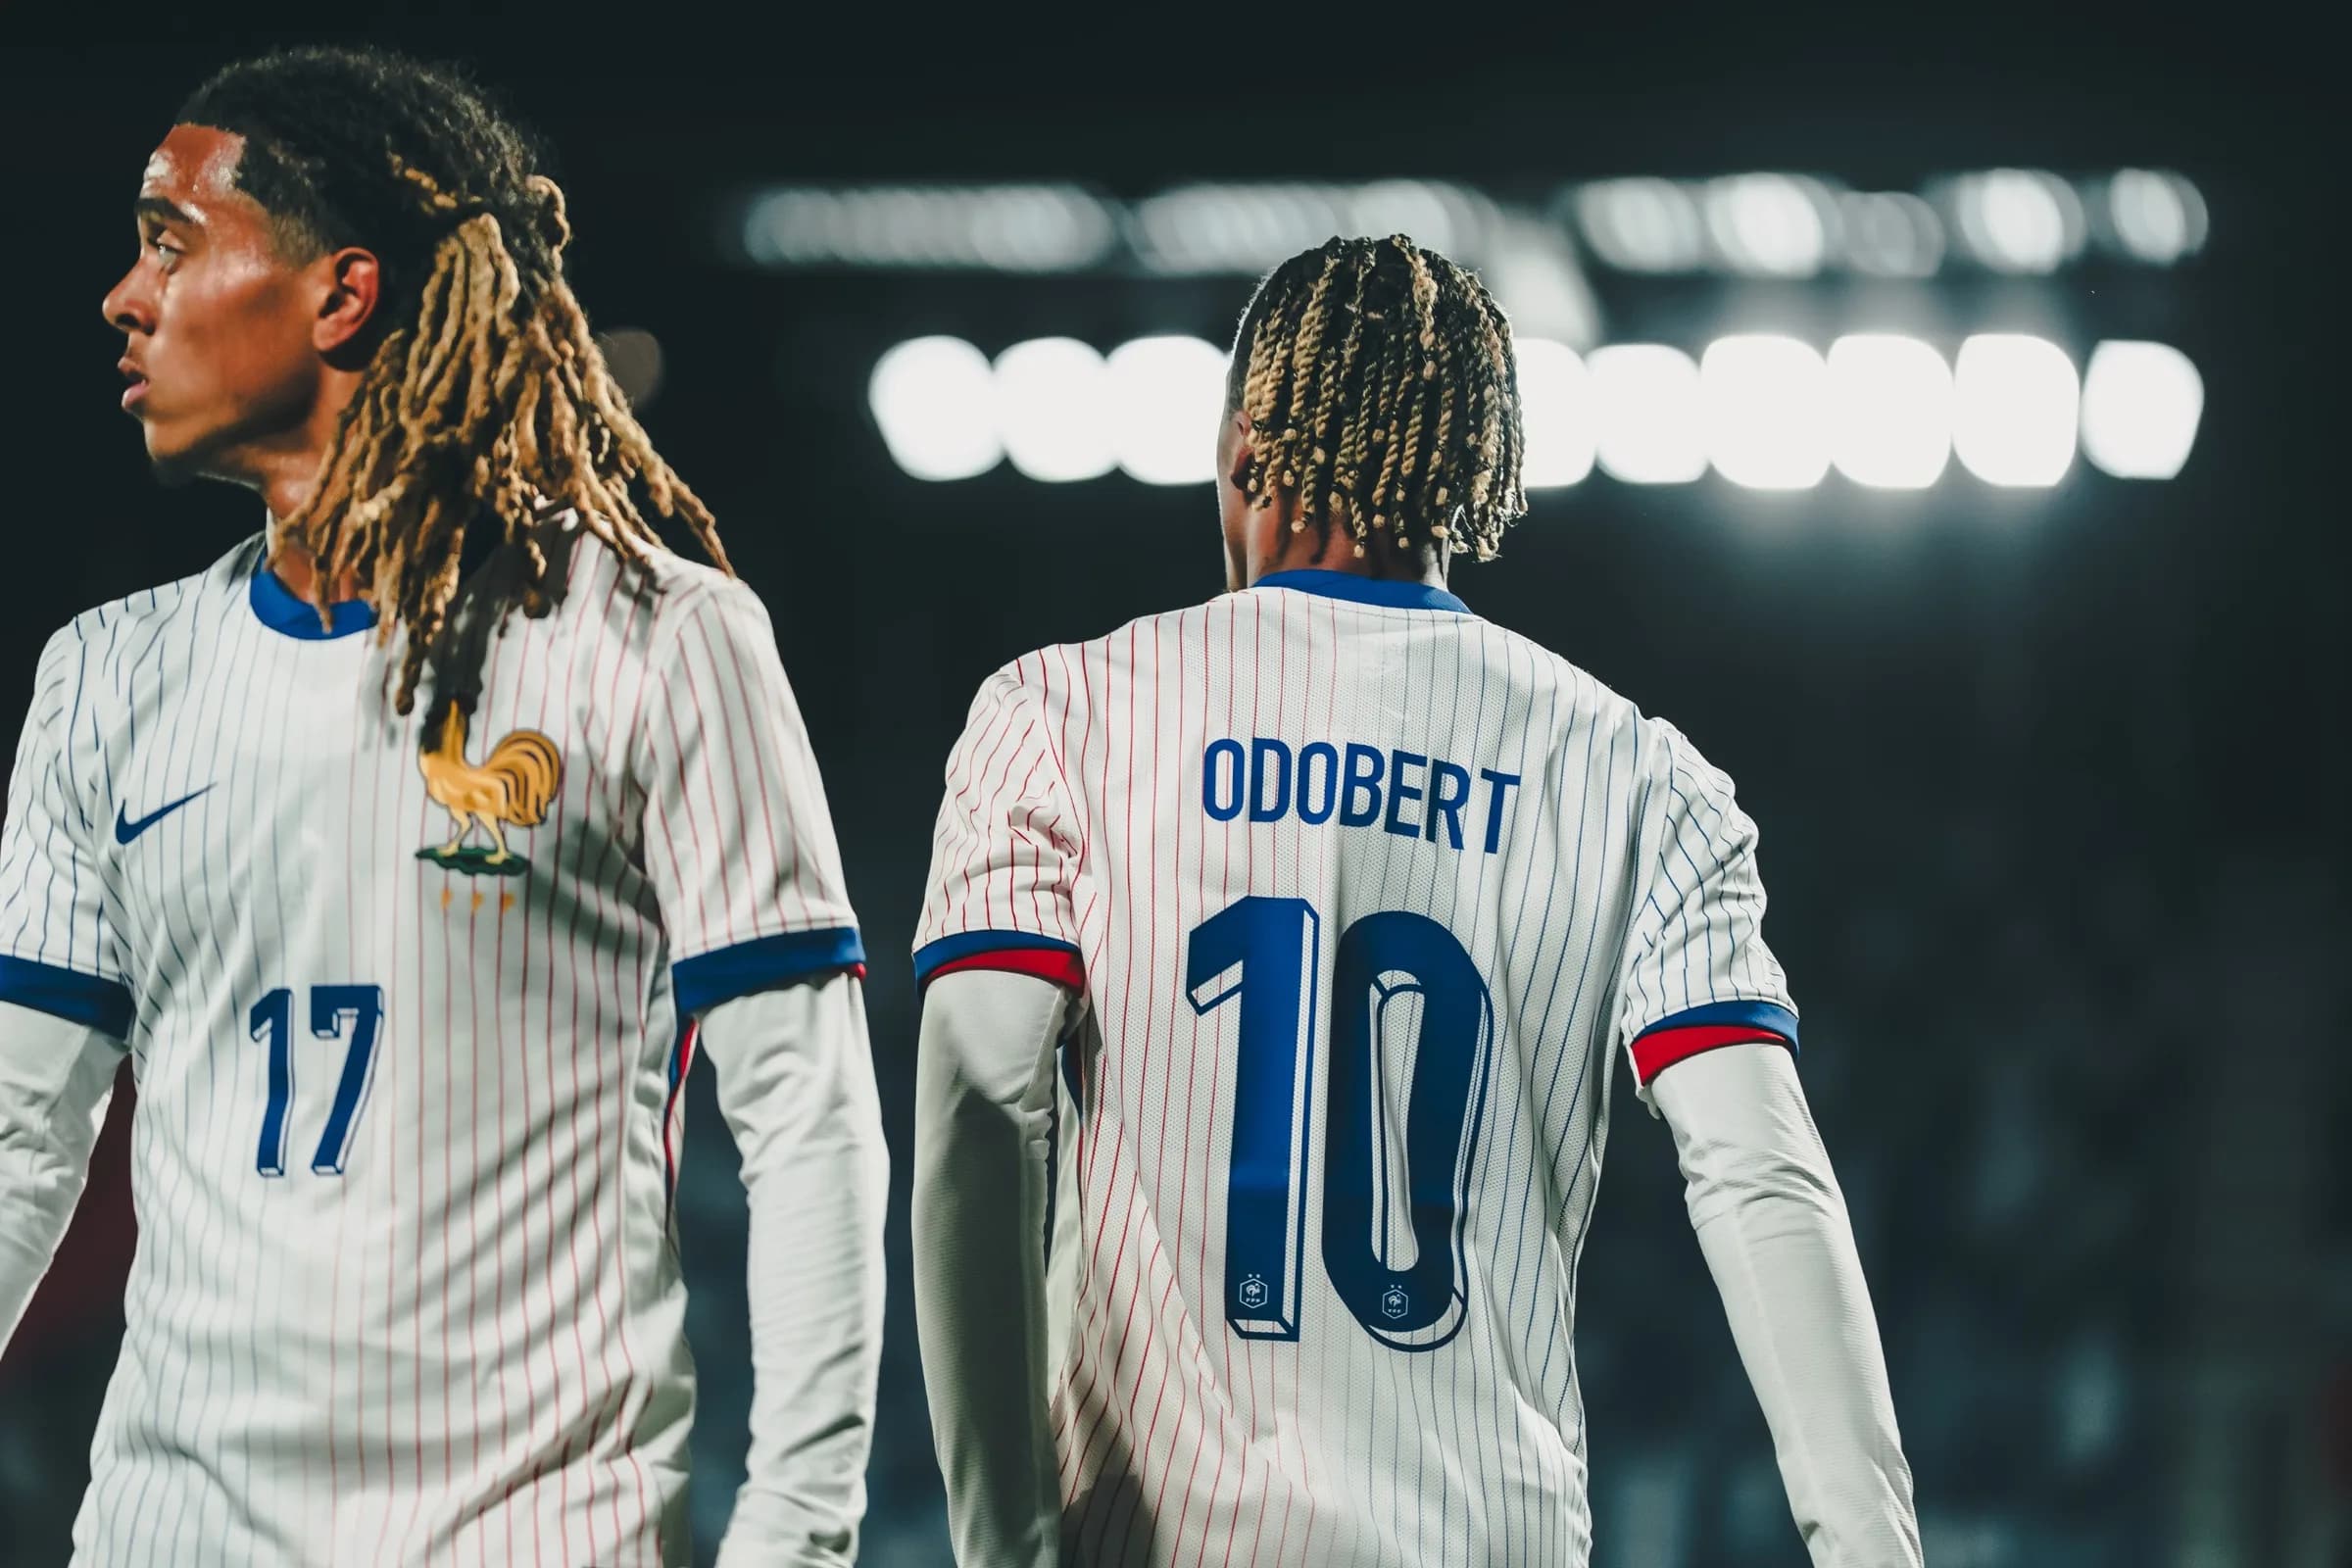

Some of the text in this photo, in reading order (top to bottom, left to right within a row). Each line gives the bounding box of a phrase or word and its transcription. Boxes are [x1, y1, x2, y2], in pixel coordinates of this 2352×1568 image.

[1202, 737, 1521, 855] ODOBERT
[250, 984, 384, 1177] 17
[1186, 895, 1494, 1352] 10
